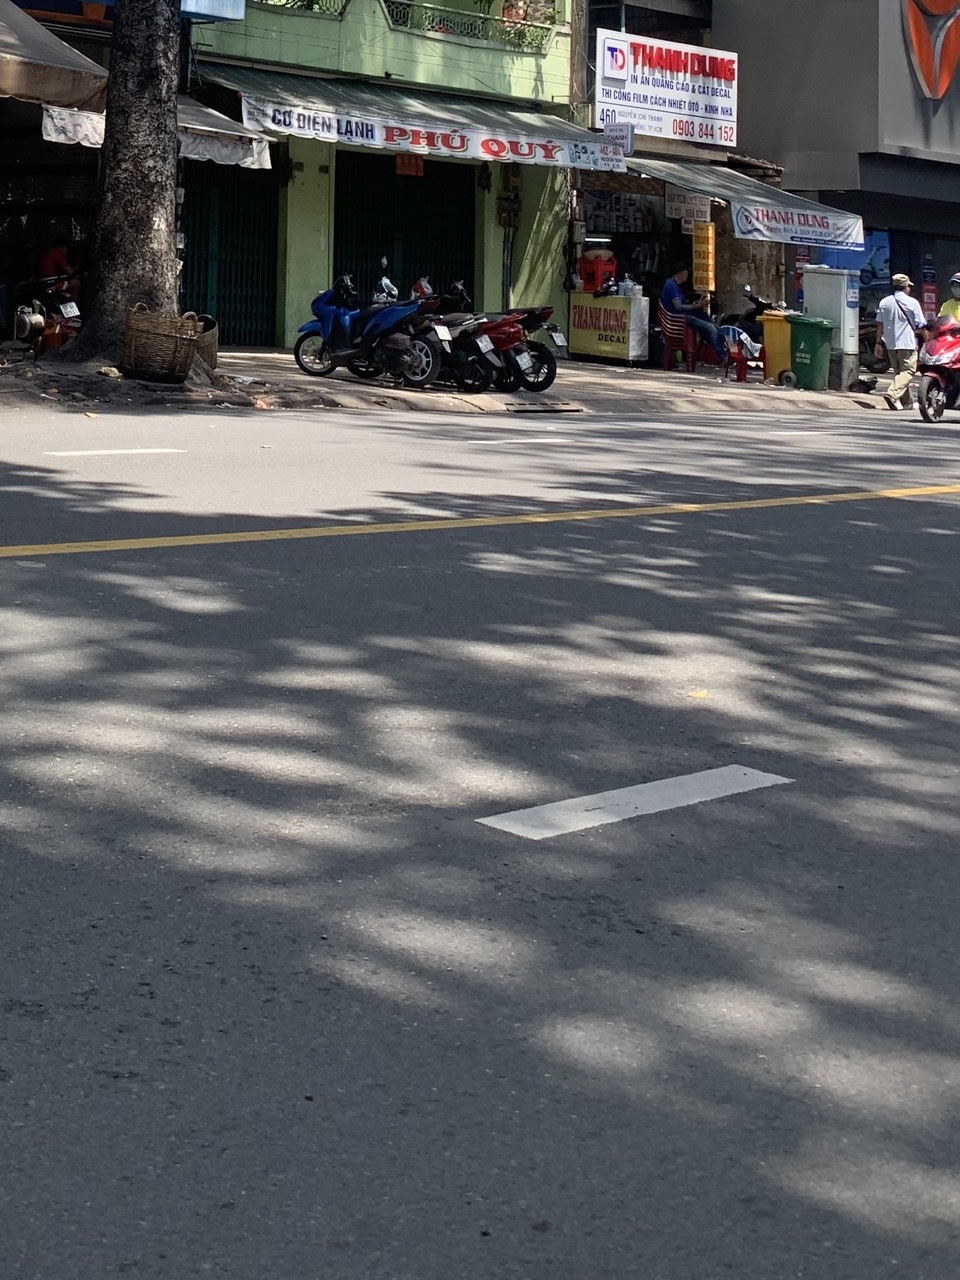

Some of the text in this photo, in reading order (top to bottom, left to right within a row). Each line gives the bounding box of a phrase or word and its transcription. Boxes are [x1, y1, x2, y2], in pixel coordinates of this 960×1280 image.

[630, 42, 690, 74] THANH
[689, 52, 736, 82] DUNG
[601, 88, 612, 99] THI
[632, 93, 648, 104] FILM
[630, 74, 638, 84] IN
[690, 86, 696, 94] &
[710, 87, 732, 99] DECAL
[600, 108, 616, 125] 460
[271, 108, 293, 128] CƠ
[296, 111, 333, 138] ĐIỆN
[336, 119, 374, 142] LẠNH
[383, 125, 469, 150] PHÚ
[481, 139, 563, 161] QUÝ
[672, 119, 734, 143] 0903 844 152
[754, 208, 794, 225] THANH
[797, 213, 829, 229] DUNG
[597, 333, 628, 345] DECAL
